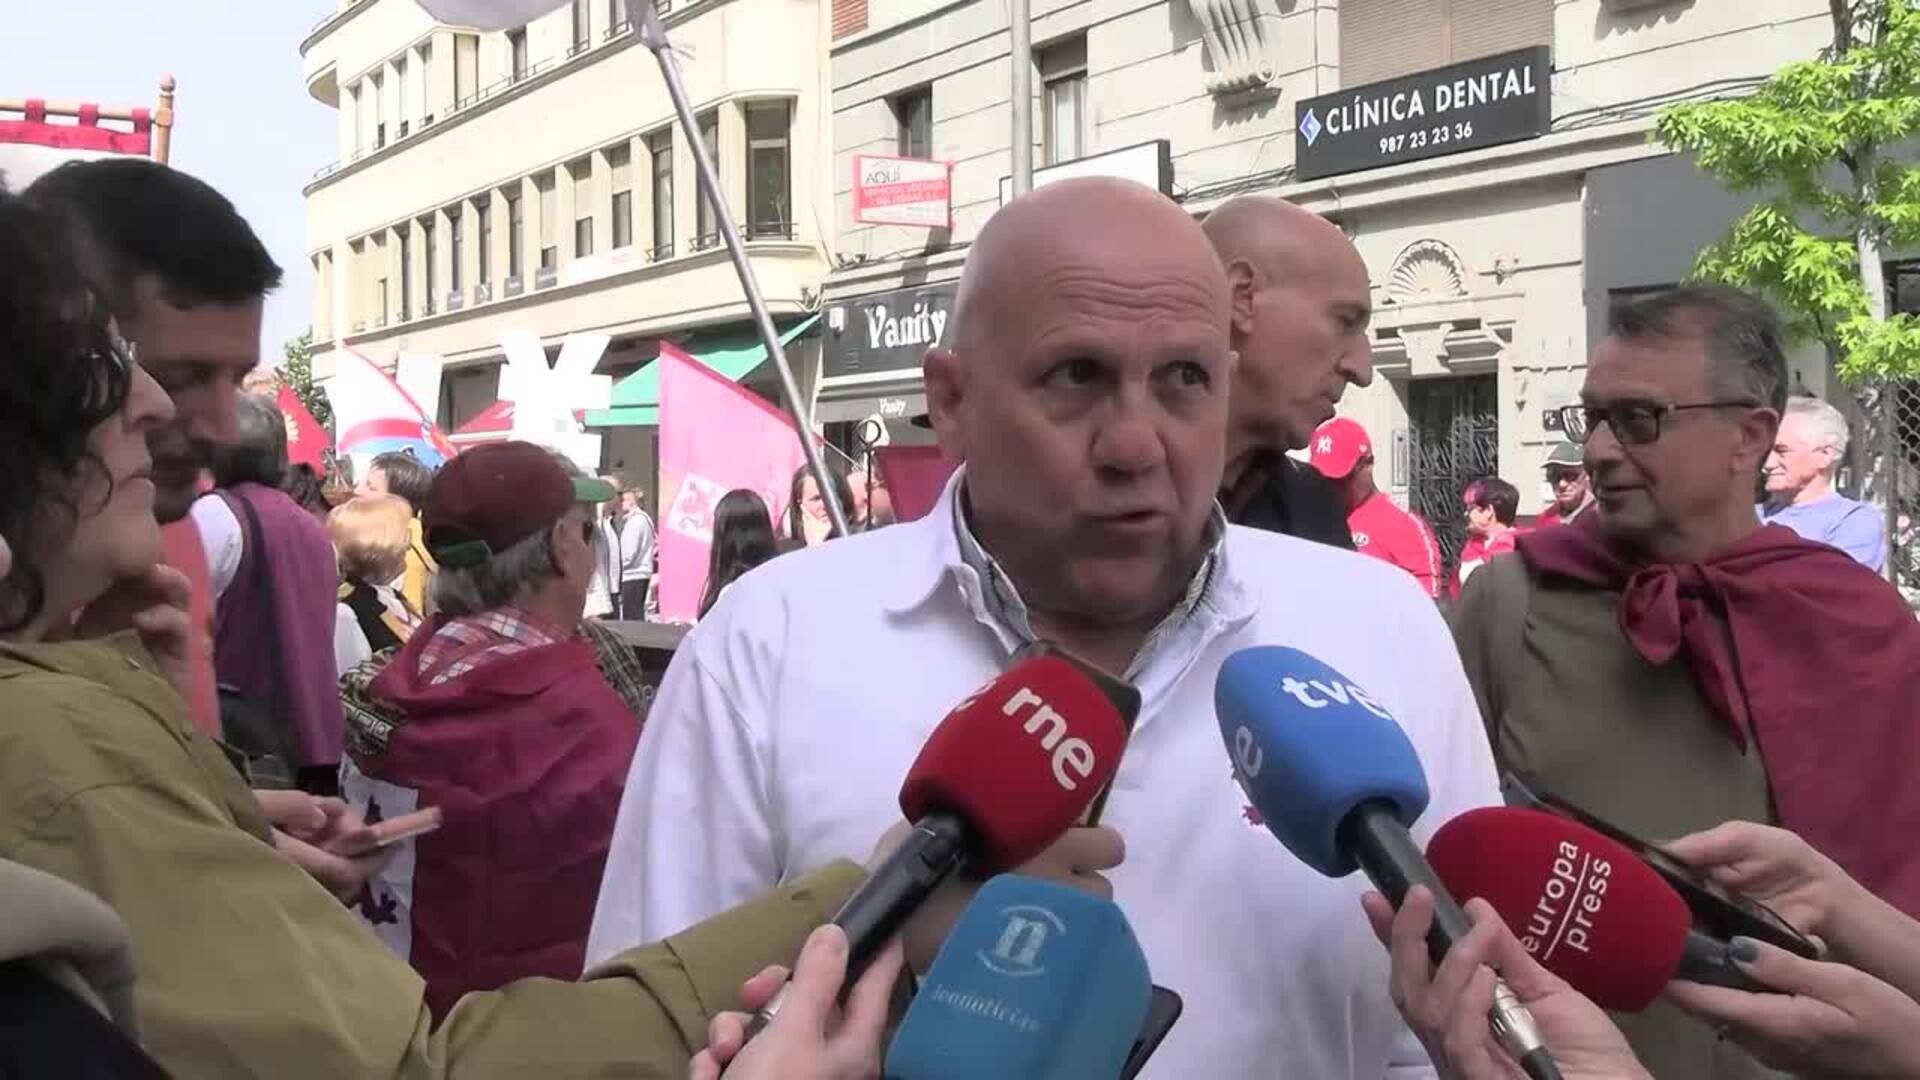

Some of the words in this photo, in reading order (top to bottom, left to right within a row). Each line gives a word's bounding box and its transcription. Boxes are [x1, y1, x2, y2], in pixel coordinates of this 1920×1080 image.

[1325, 88, 1425, 135] CLÍNICA
[1435, 65, 1537, 113] DENTAL
[1379, 134, 1405, 154] 987
[1409, 130, 1427, 149] 23
[1432, 126, 1450, 145] 23
[1454, 121, 1473, 140] 36
[864, 303, 947, 349] Vanity
[879, 398, 907, 416] Vanity
[1002, 686, 1095, 791] rne
[1521, 840, 1578, 954] europa
[1565, 858, 1611, 953] press
